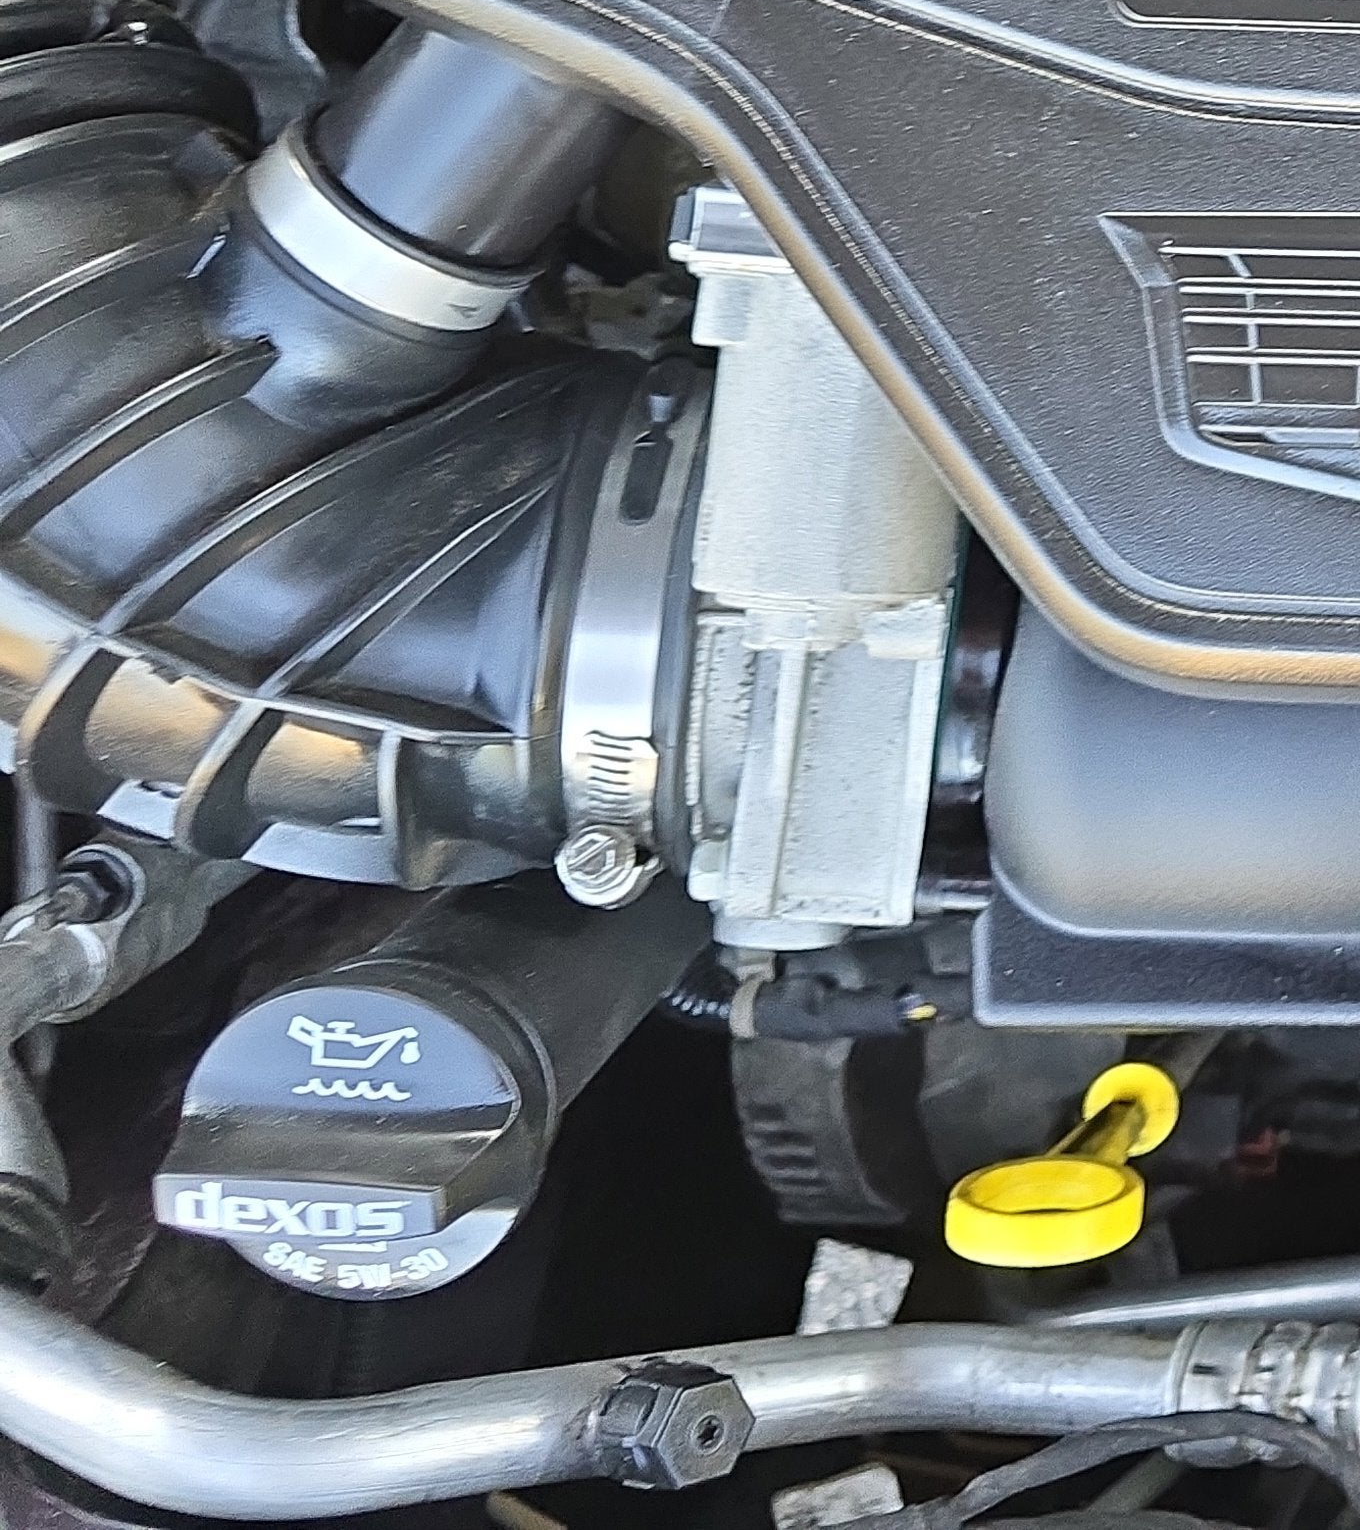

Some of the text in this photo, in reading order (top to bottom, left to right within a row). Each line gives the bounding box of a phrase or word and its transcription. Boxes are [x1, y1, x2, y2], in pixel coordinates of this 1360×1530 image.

[174, 1182, 412, 1237] dexos
[263, 1242, 450, 1290] SAE 5W-30
